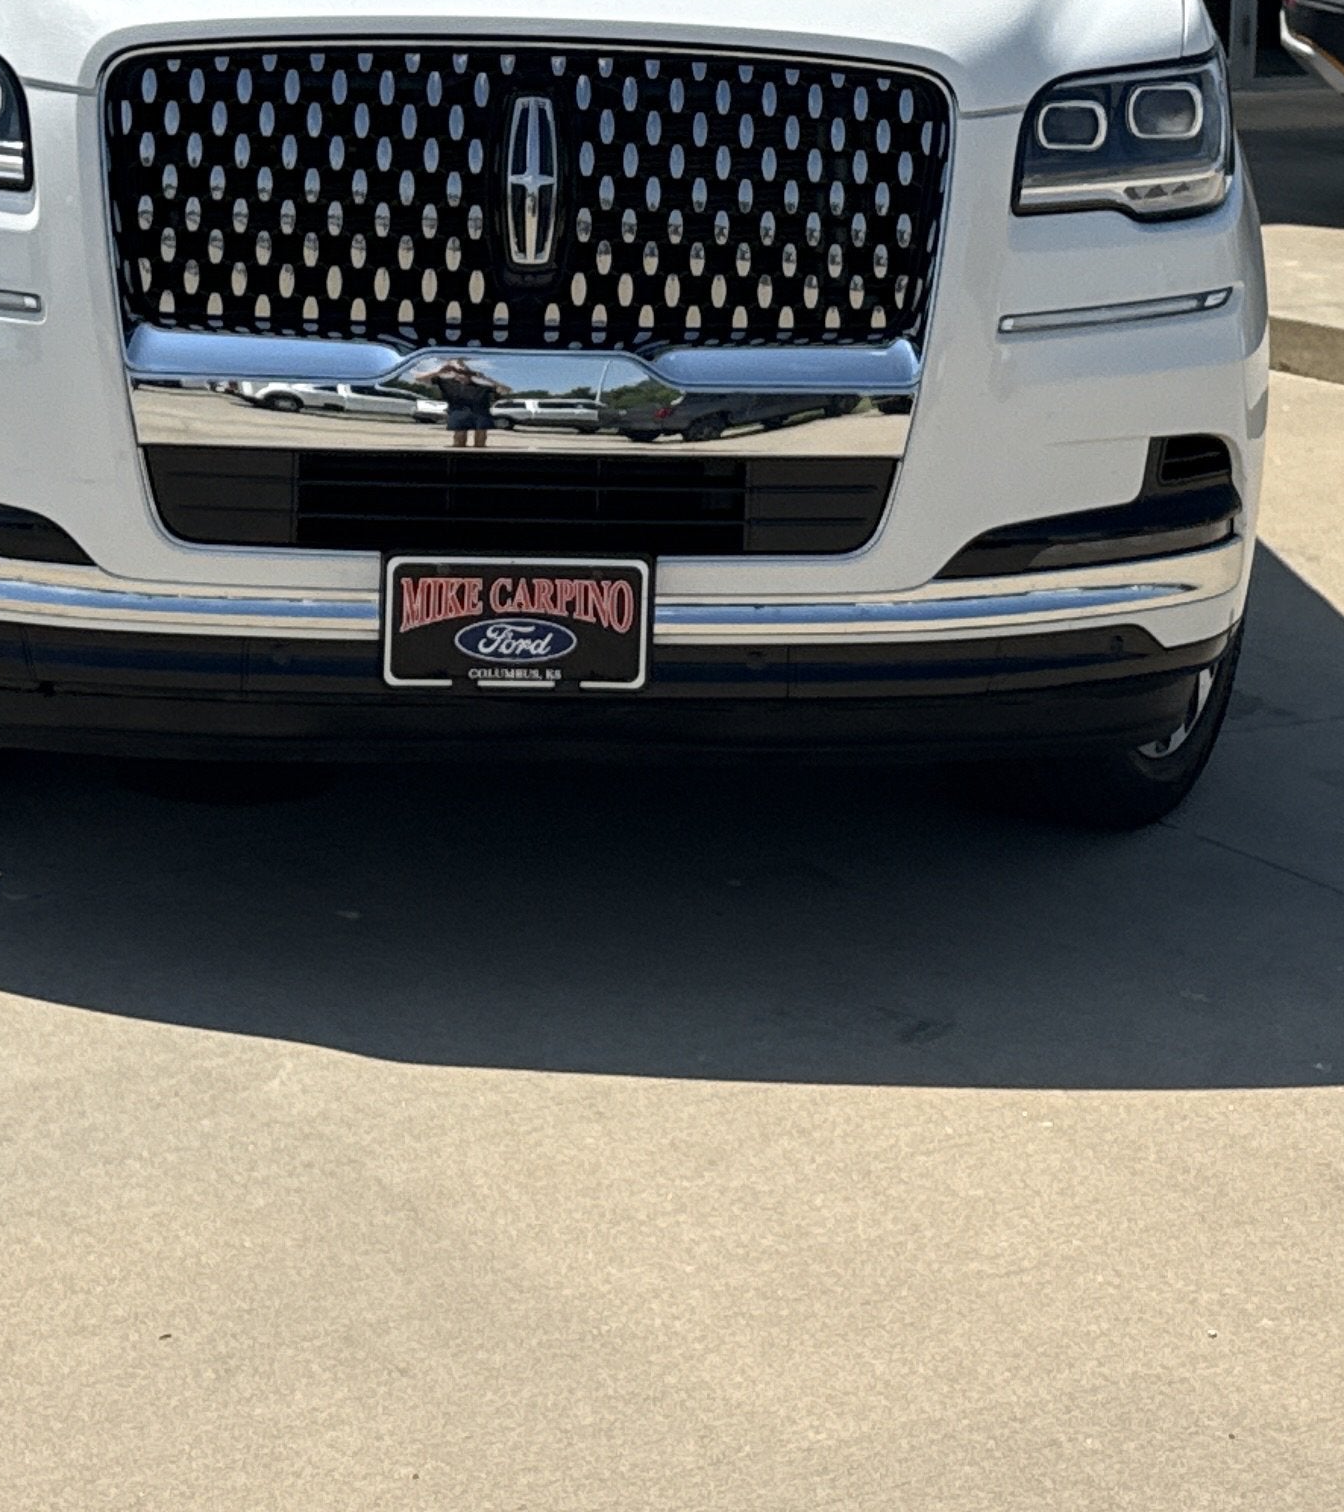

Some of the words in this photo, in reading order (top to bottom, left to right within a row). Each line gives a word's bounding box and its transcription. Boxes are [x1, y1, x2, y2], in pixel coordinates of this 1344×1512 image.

[400, 577, 483, 633] MIKE
[489, 577, 635, 634] CARPINO
[478, 623, 554, 655] Ford
[545, 668, 562, 680] KS
